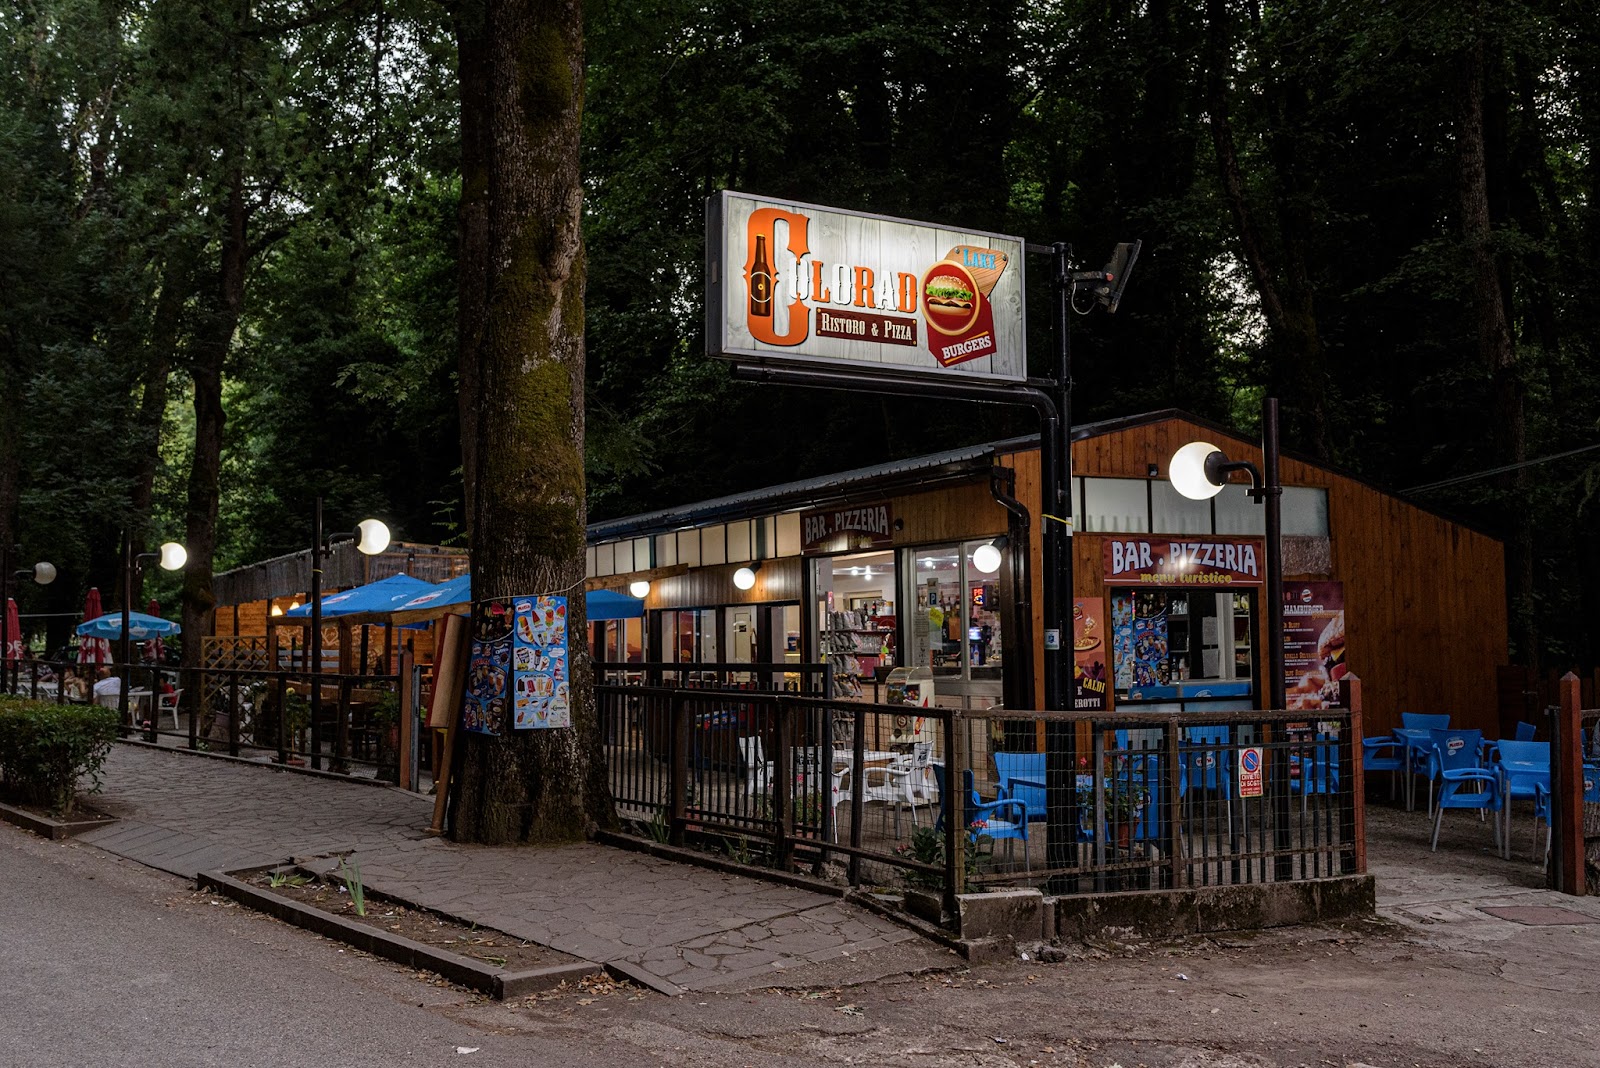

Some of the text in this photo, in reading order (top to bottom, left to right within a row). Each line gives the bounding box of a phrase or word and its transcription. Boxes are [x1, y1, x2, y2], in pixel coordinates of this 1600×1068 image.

[963, 248, 996, 270] LAKE
[821, 312, 913, 341] RISTORO & PIZZA
[942, 336, 992, 360] BURGERS
[804, 515, 827, 545] BAR
[834, 505, 889, 536] PIZZERIA
[1111, 541, 1154, 575] BAR
[1169, 541, 1258, 577] PIZZERIA
[1140, 571, 1233, 584] menu turistico
[1082, 677, 1105, 693] CALDI
